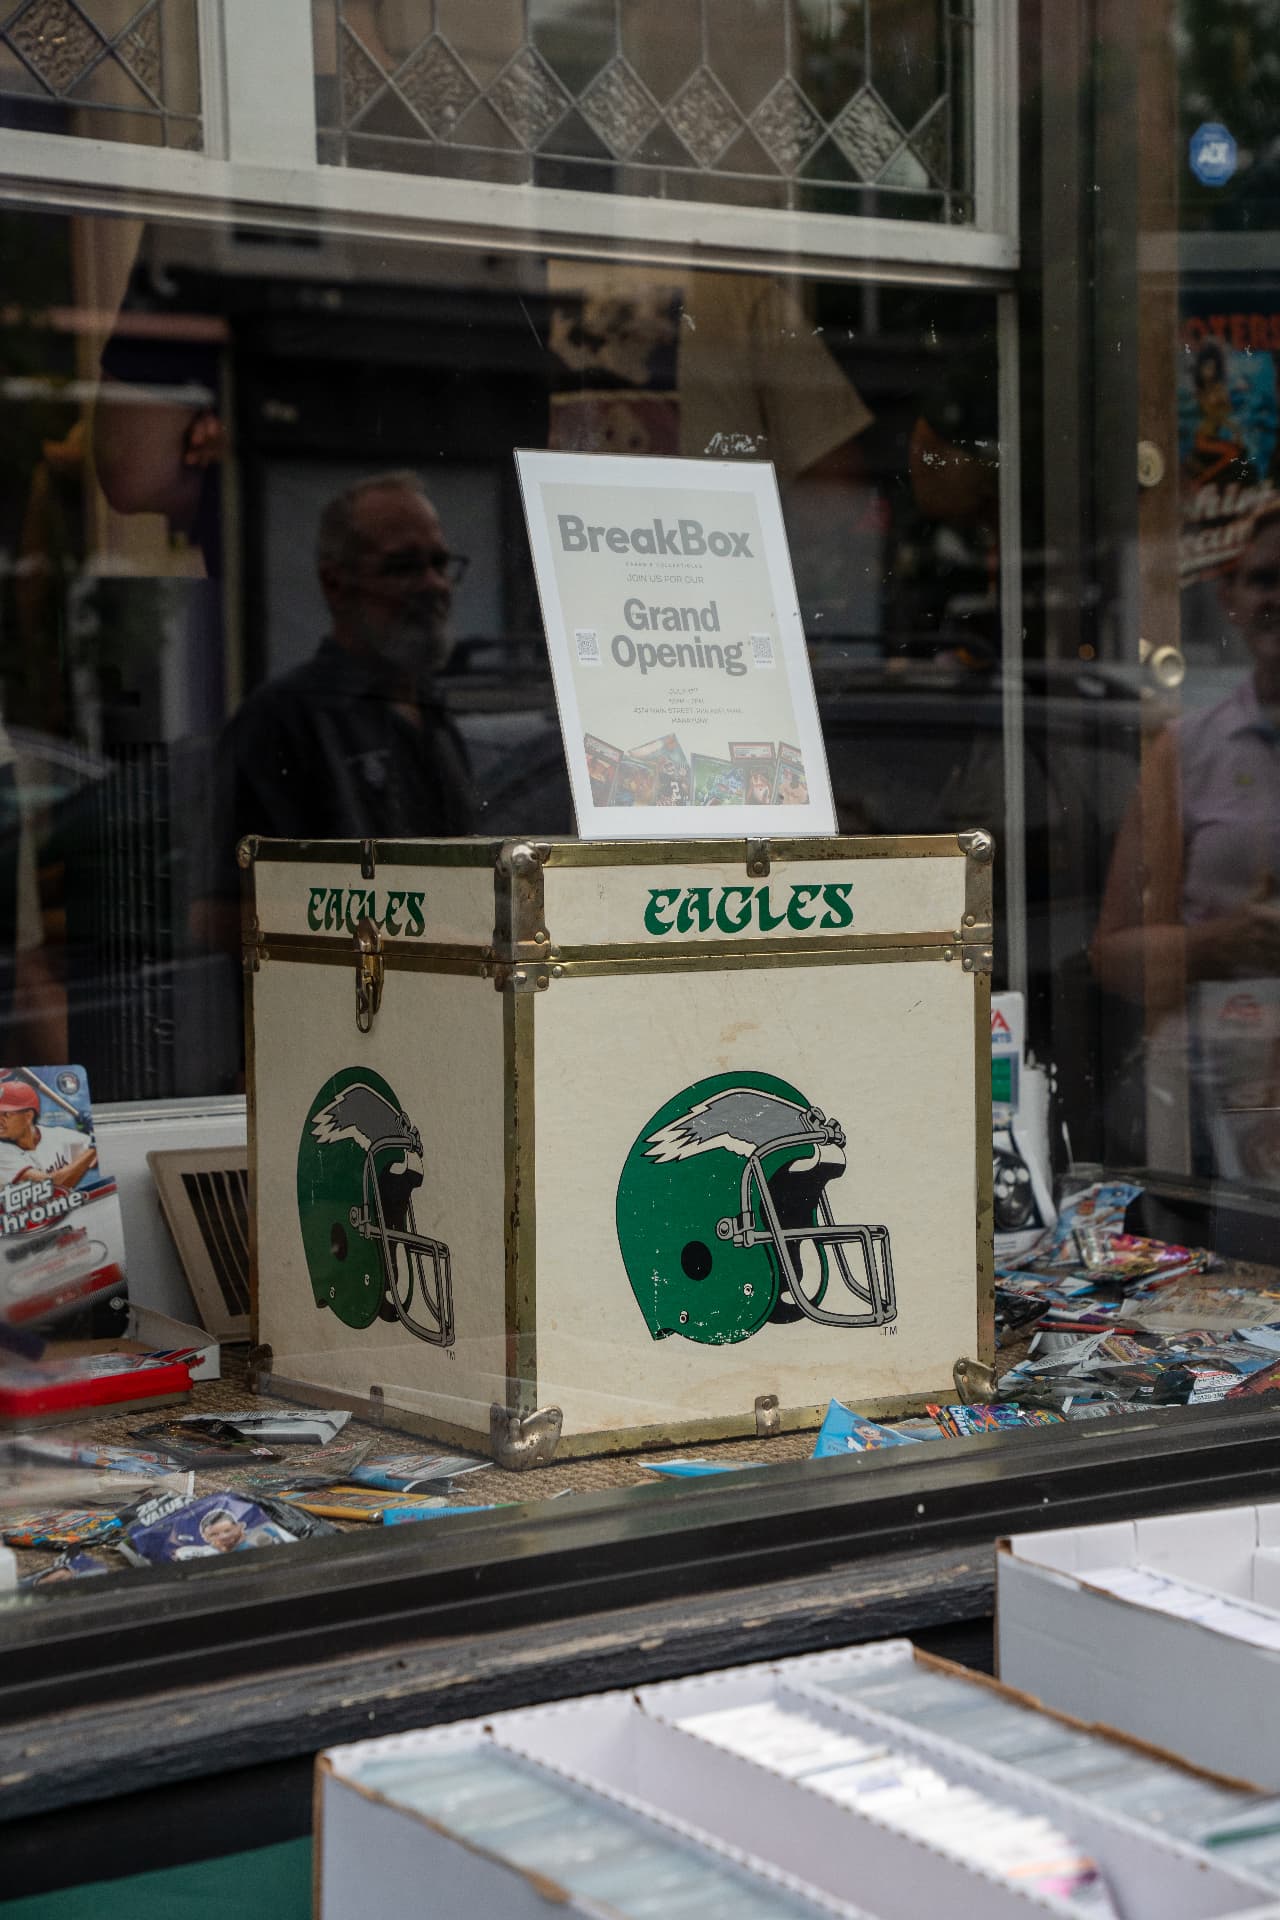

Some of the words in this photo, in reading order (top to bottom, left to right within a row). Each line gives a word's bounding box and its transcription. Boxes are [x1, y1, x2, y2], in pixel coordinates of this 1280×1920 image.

[557, 514, 755, 559] BreakBox
[626, 573, 648, 584] JOIN
[649, 574, 663, 583] US
[664, 575, 682, 584] FOR
[684, 576, 705, 584] OUR
[624, 598, 721, 633] Grand
[611, 634, 748, 677] Opening
[307, 887, 426, 937] EAGLES
[644, 883, 854, 936] EAGLES
[0, 1191, 83, 1237] hrome
[882, 1326, 898, 1336] TM
